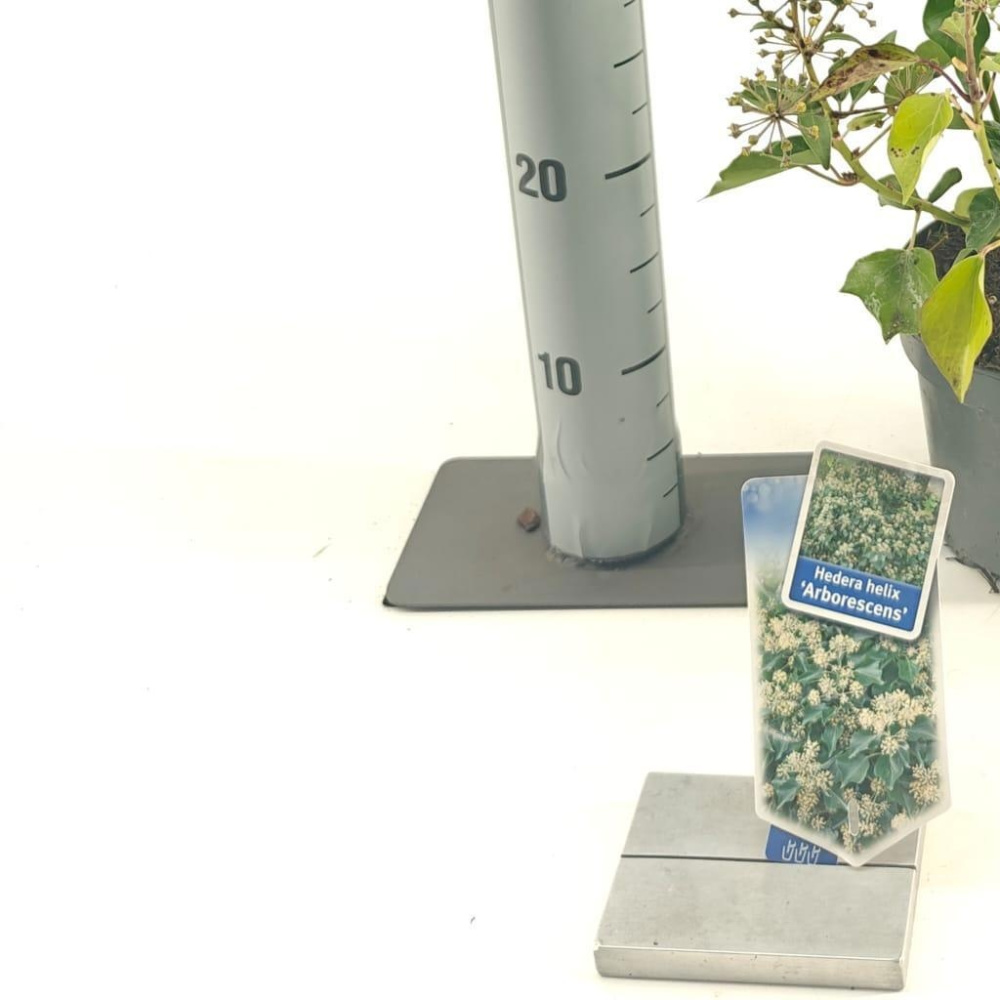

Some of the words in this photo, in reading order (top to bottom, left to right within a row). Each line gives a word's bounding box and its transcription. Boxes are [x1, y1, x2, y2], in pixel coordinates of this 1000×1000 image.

[515, 152, 567, 203] 20
[537, 350, 582, 397] 10
[814, 566, 863, 590] Hedera
[866, 578, 901, 600] helix
